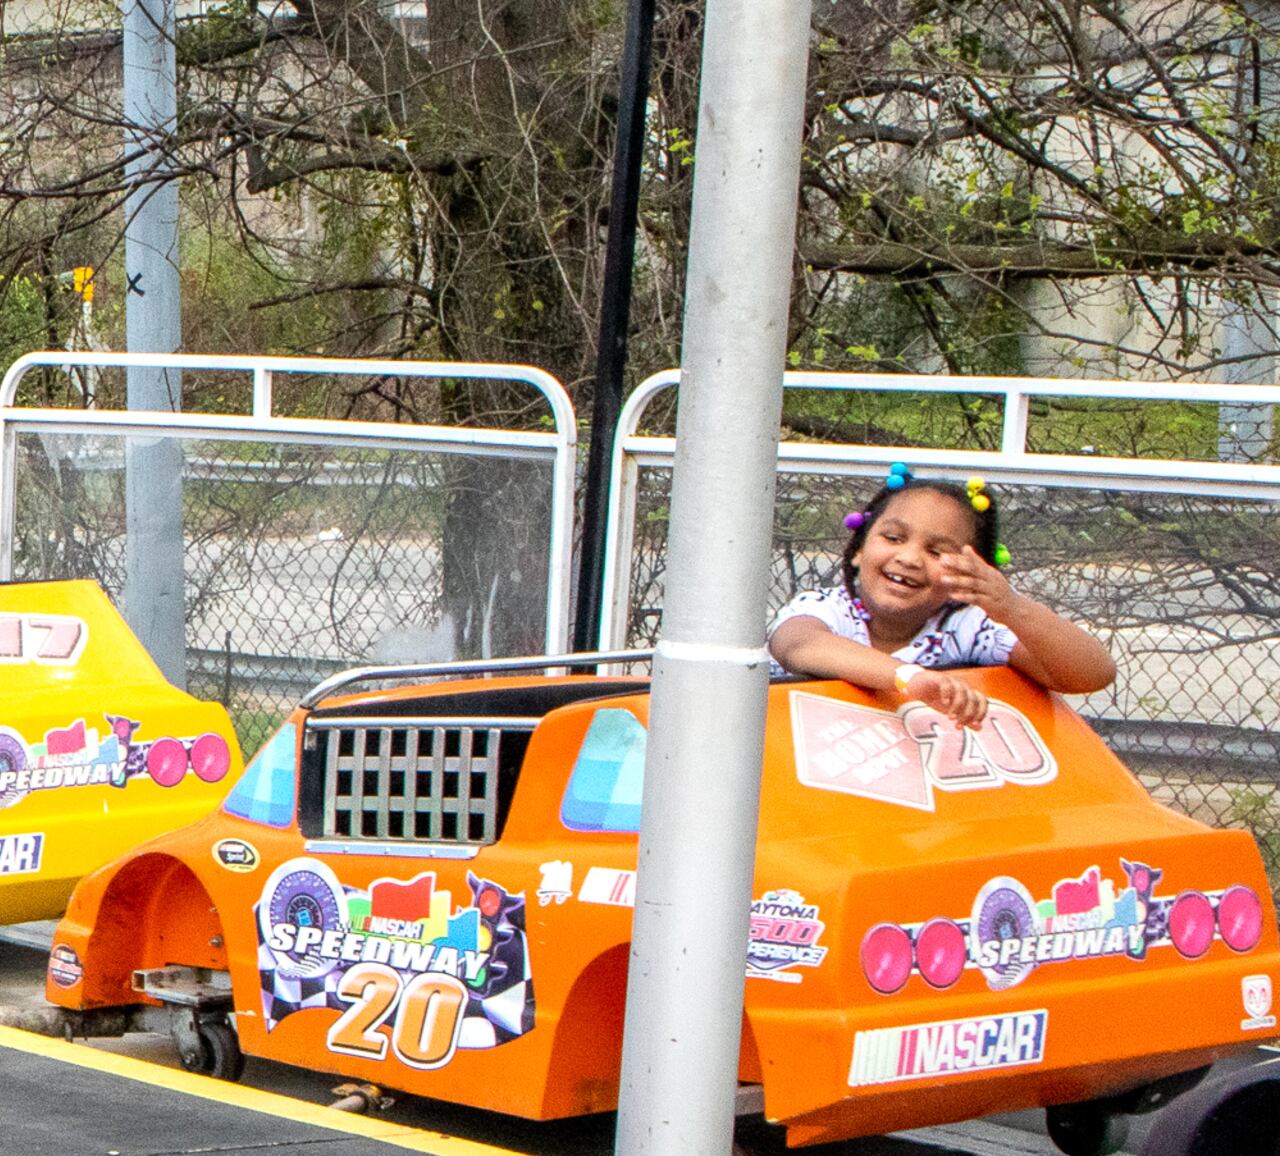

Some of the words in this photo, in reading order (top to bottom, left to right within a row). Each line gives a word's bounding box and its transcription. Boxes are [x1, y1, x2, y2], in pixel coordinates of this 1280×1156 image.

[902, 698, 1052, 785] 20
[369, 916, 424, 939] NASCAR
[750, 902, 816, 919] AYTONA
[269, 922, 490, 980] SPEEDWAY
[978, 923, 1146, 968] SPEEDWAY
[328, 964, 467, 1068] 20
[914, 1013, 1040, 1074] NASCAR
